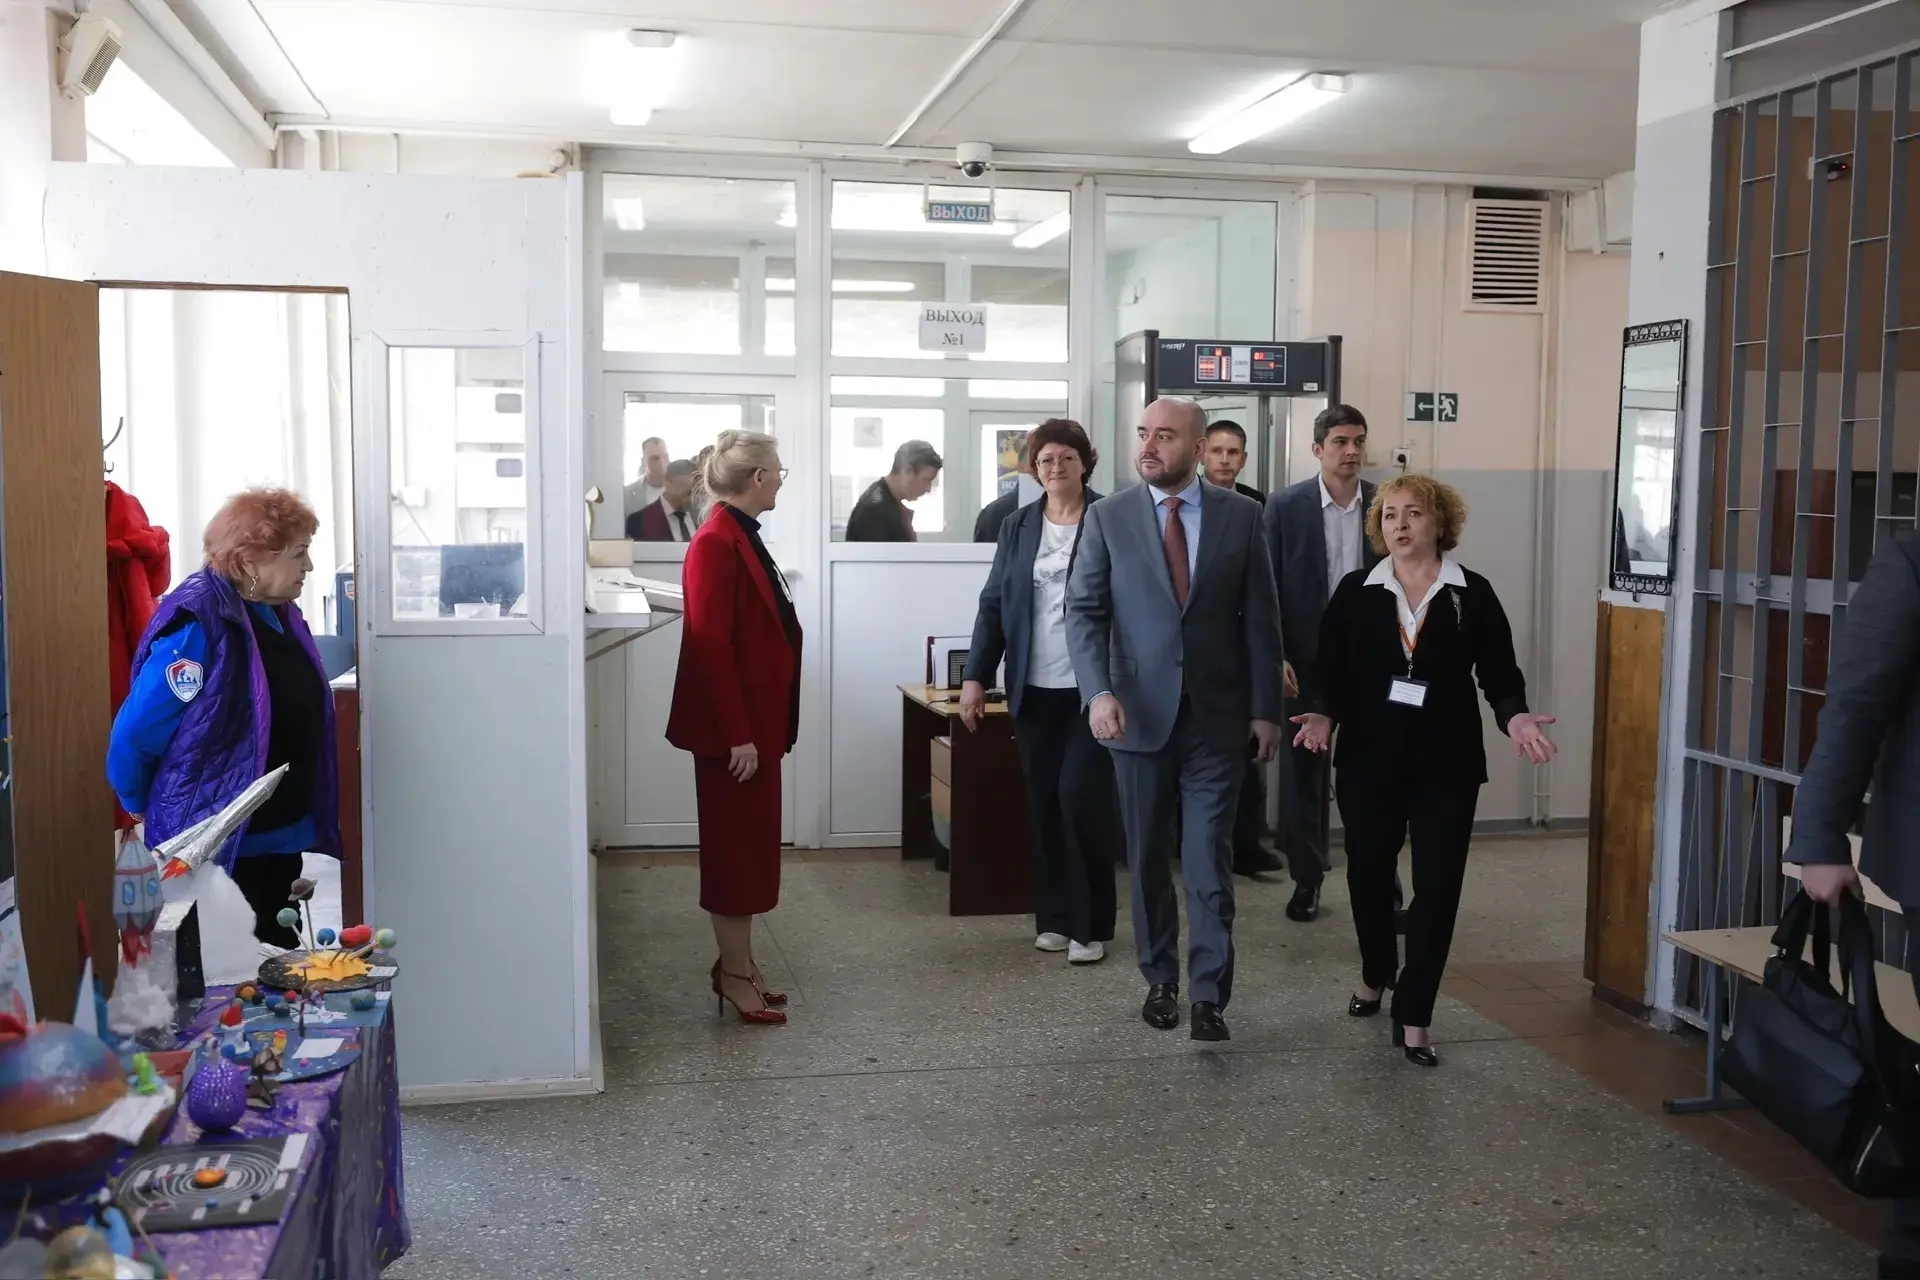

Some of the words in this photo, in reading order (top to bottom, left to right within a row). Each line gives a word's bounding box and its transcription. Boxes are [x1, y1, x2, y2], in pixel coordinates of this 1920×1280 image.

[931, 204, 988, 221] ВЫХОД
[926, 309, 984, 326] ВЫХОД
[942, 333, 964, 346] №1
